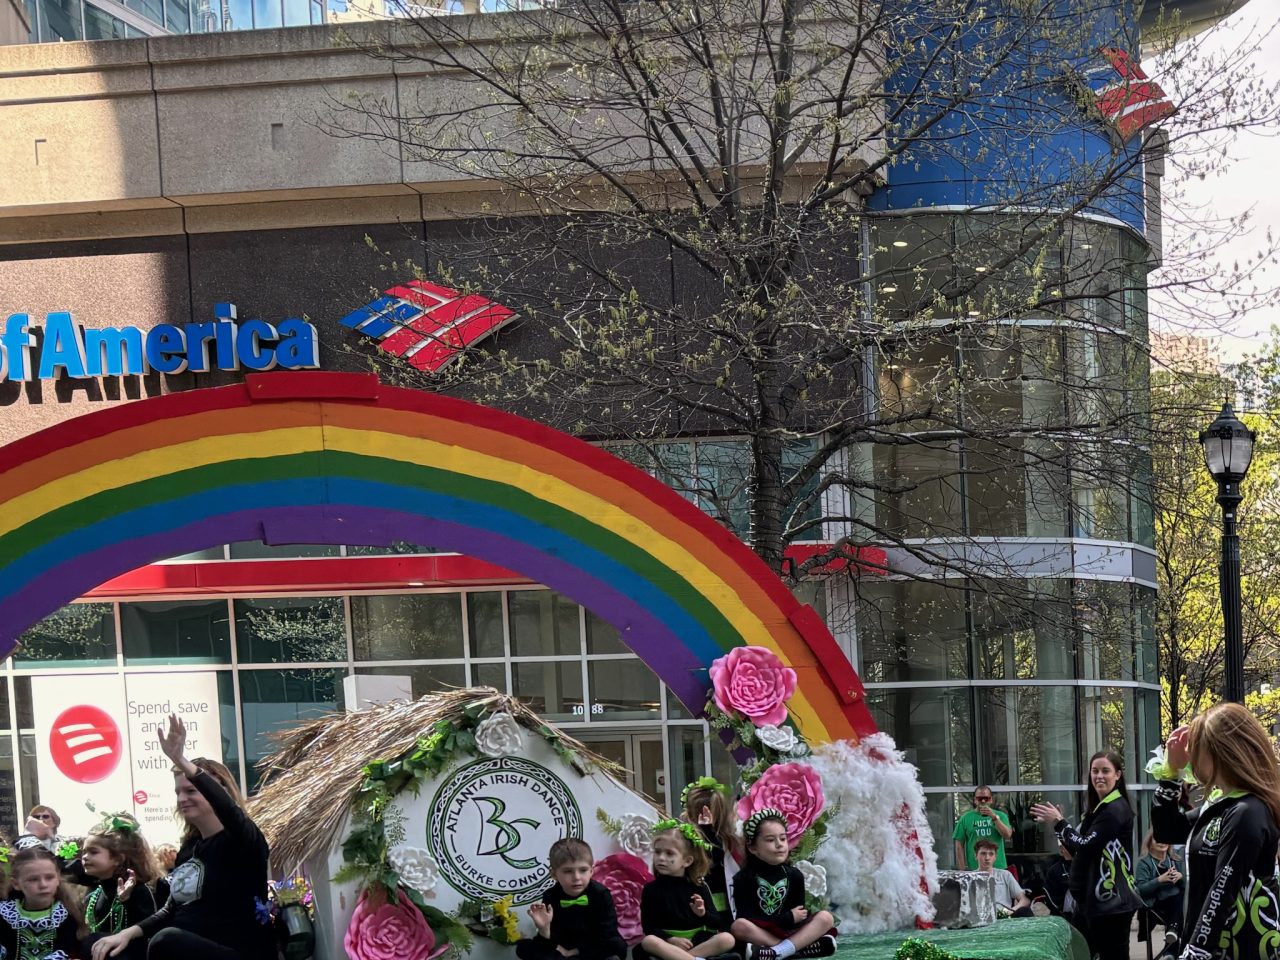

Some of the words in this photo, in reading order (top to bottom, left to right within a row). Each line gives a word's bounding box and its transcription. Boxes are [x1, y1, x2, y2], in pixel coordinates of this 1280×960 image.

[0, 313, 36, 382] f
[38, 302, 321, 379] America
[178, 702, 208, 713] save
[138, 756, 168, 769] with
[446, 777, 488, 833] ATLANTA
[490, 774, 529, 787] IRISH
[531, 783, 564, 827] DANCE
[975, 828, 992, 836] YOU
[455, 855, 494, 886] BURKE
[1196, 865, 1234, 946] #mightyBC
